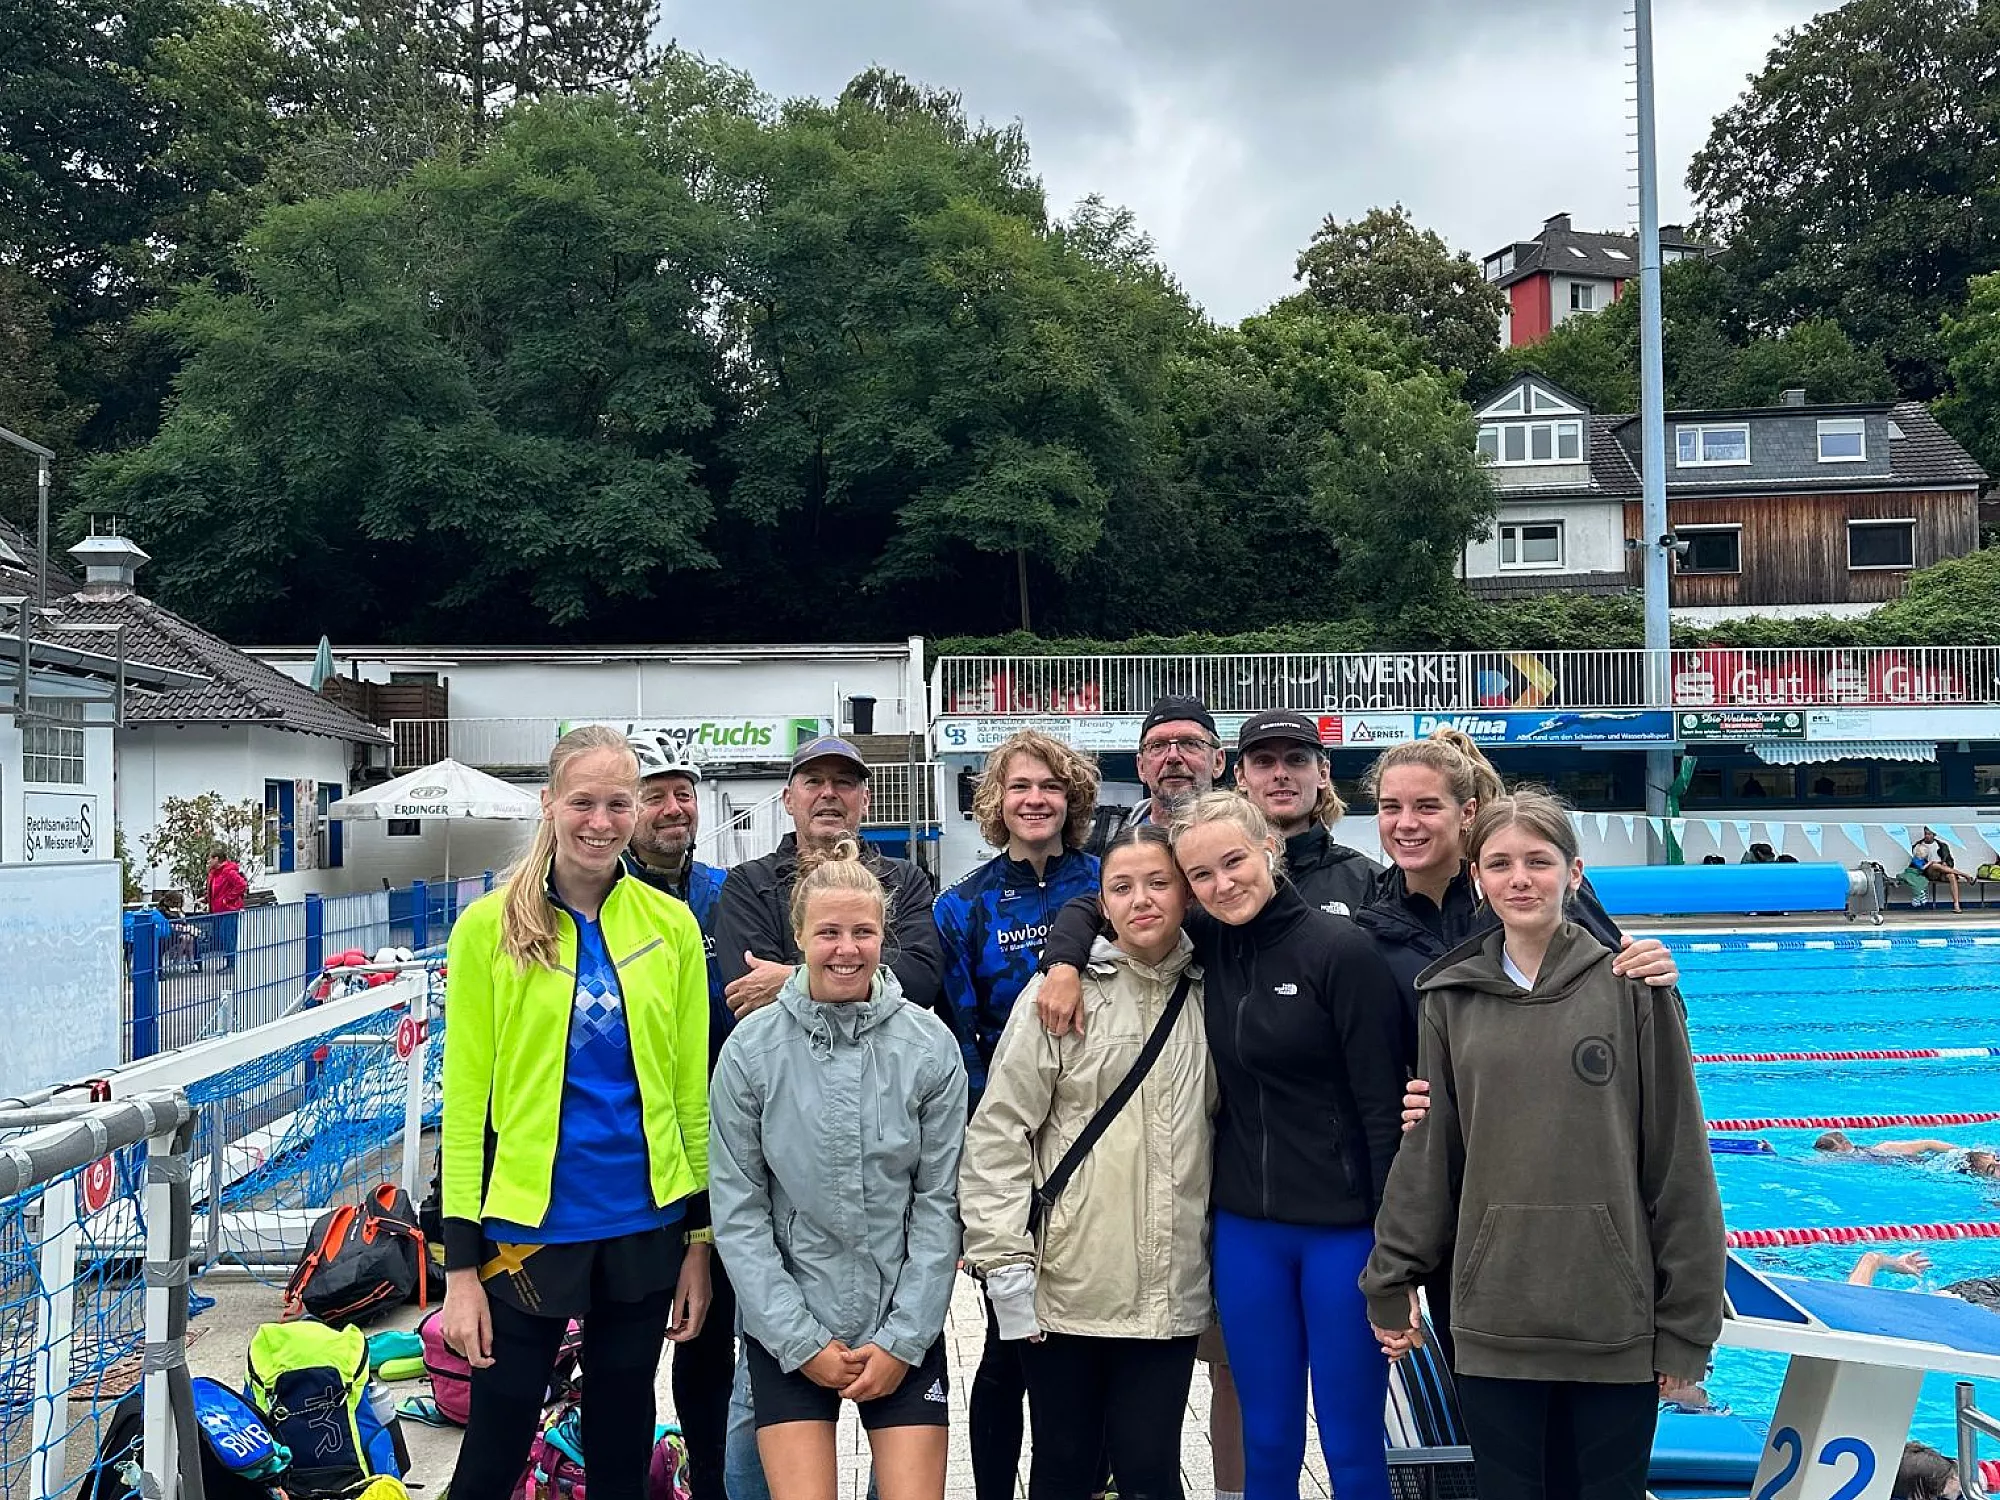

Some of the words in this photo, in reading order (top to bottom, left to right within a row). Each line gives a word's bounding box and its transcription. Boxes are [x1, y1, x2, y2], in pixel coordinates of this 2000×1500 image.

[626, 721, 772, 745] LerFuchs
[394, 805, 448, 815] ERDINGER
[997, 924, 1054, 944] bwbo
[305, 1386, 344, 1459] TYR
[220, 1423, 272, 1458] BWB
[560, 1461, 586, 1476] Sa
[1818, 1437, 1876, 1500] 2
